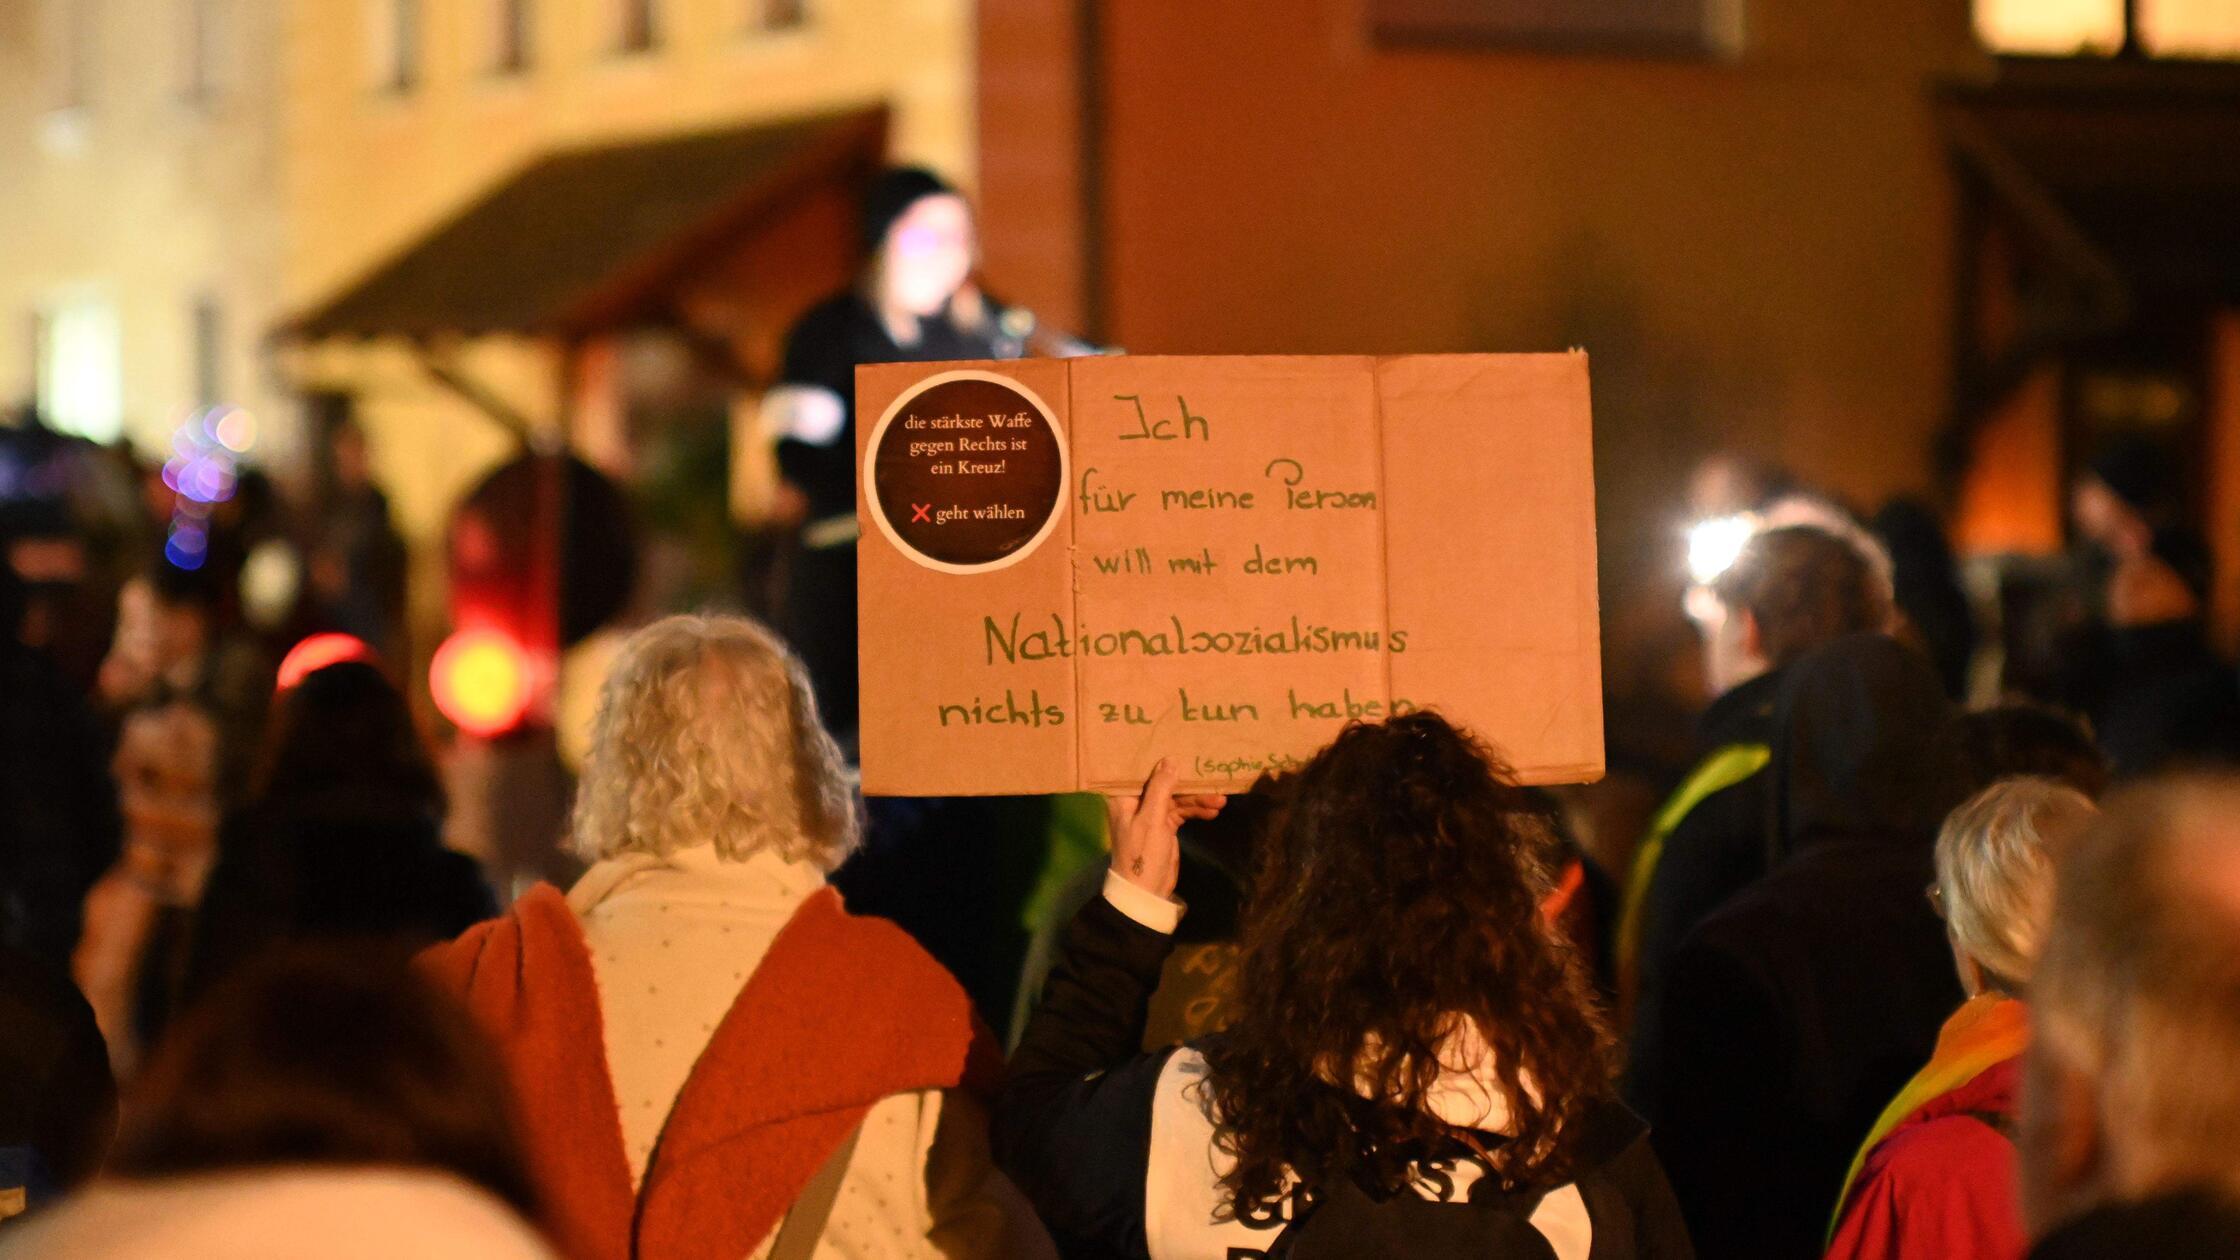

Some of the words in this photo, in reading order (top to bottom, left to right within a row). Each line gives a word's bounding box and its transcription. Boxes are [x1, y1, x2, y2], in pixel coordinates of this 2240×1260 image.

[904, 414, 926, 429] die
[931, 414, 983, 429] stärkste
[988, 412, 1032, 428] Waffe
[1113, 395, 1209, 441] Ich
[910, 440, 954, 456] gegen
[959, 436, 1007, 451] Rechts
[1011, 436, 1027, 451] ist
[931, 461, 953, 474] ein
[958, 460, 1006, 474] Kreuz!
[1079, 467, 1137, 515] für
[1161, 487, 1255, 511] meine
[1265, 458, 1377, 511] Person
[936, 505, 968, 525] geht
[973, 504, 1025, 519] wählen
[1093, 548, 1152, 576] will
[1168, 547, 1218, 576] mit
[1243, 543, 1318, 576] dem
[984, 612, 1409, 666] Nationalsozialismus
[938, 687, 1065, 728] nichts
[1098, 702, 1153, 725] zu
[1179, 687, 1260, 722] tun
[1288, 687, 1418, 719] haben
